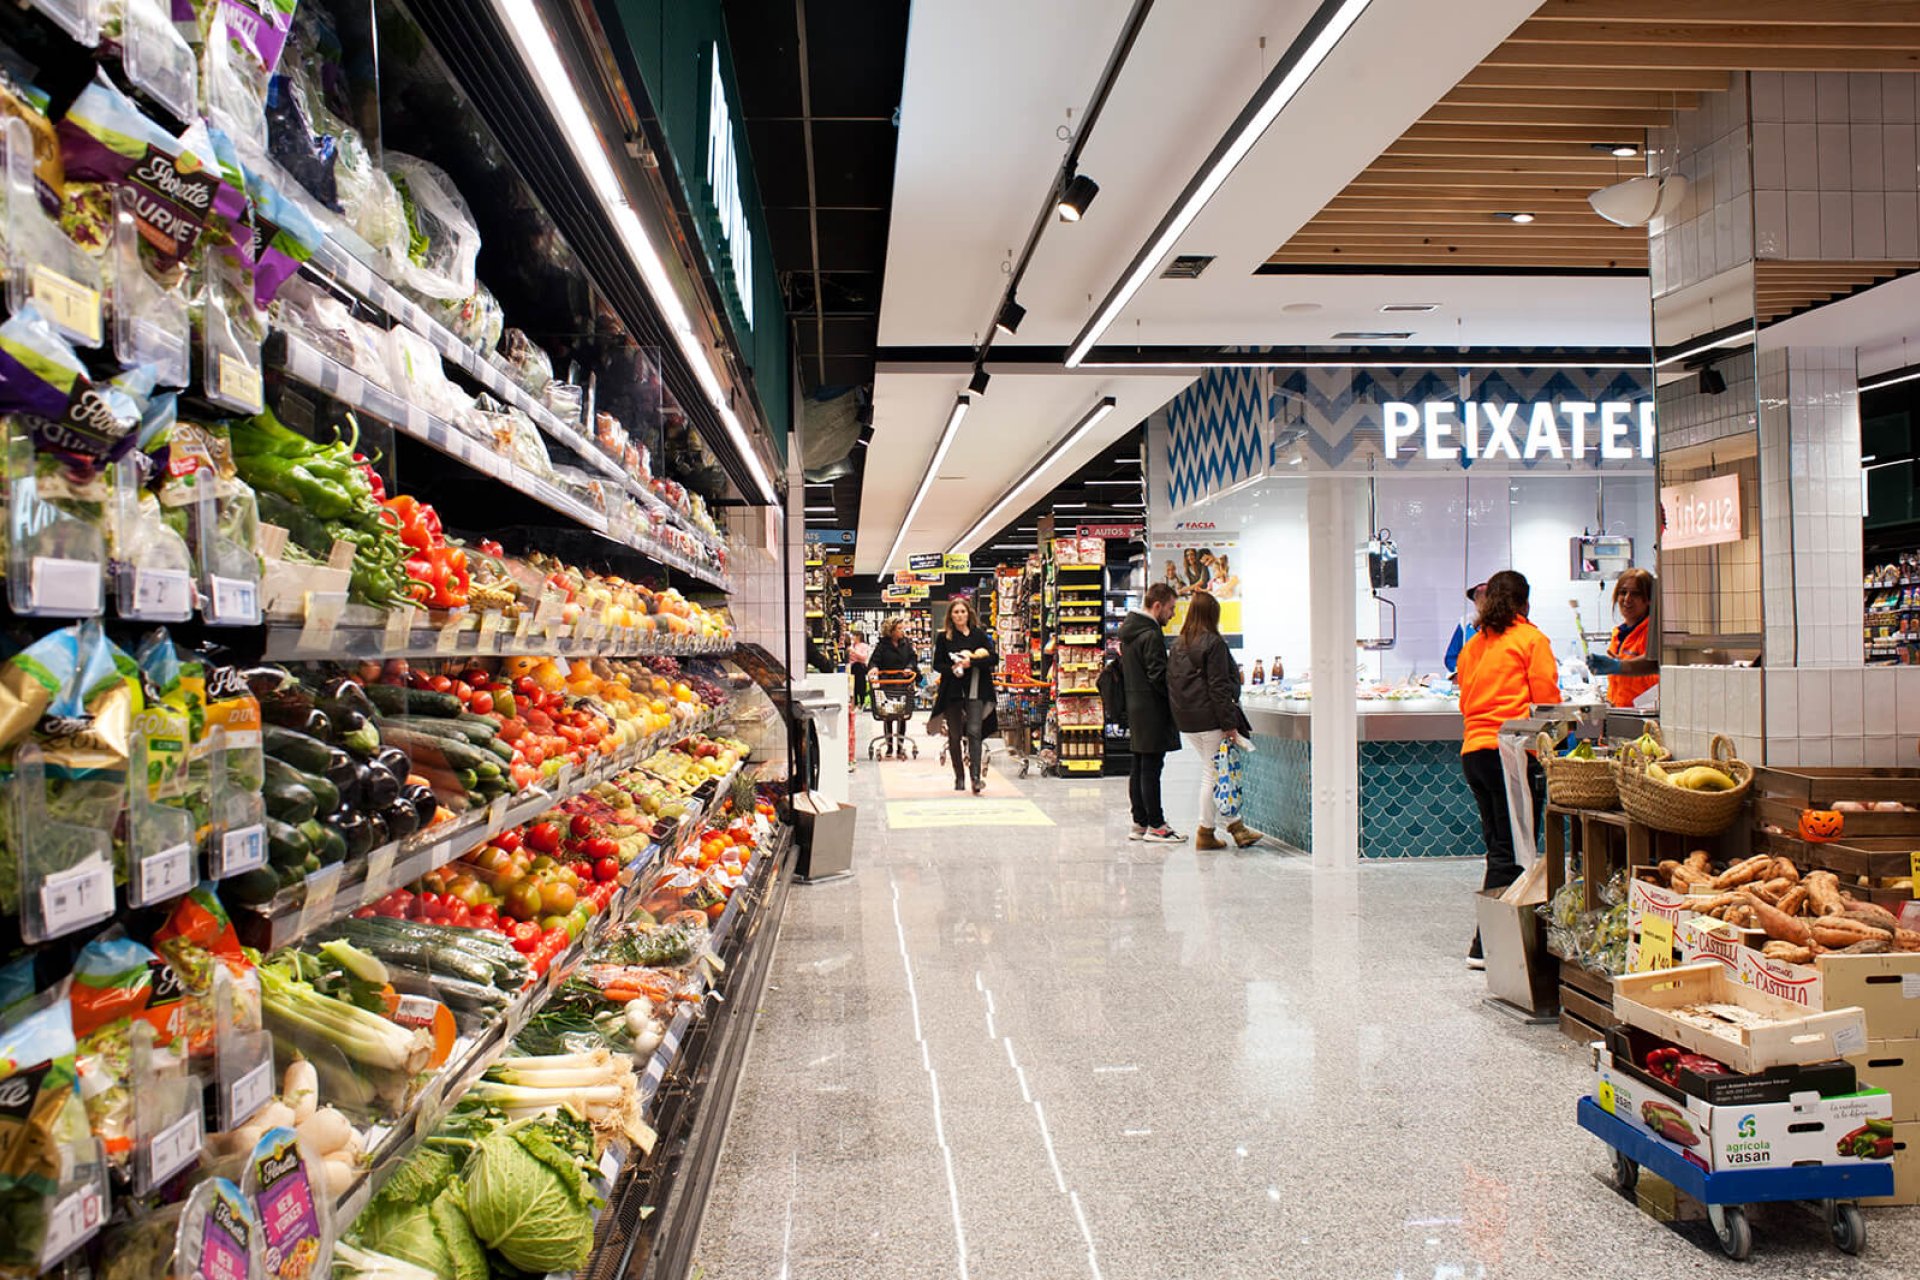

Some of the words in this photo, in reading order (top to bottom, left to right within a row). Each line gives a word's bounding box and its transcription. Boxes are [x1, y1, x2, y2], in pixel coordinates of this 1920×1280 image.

[137, 156, 209, 208] Florette
[1727, 1151, 1770, 1164] vasan
[276, 1191, 294, 1213] NEW
